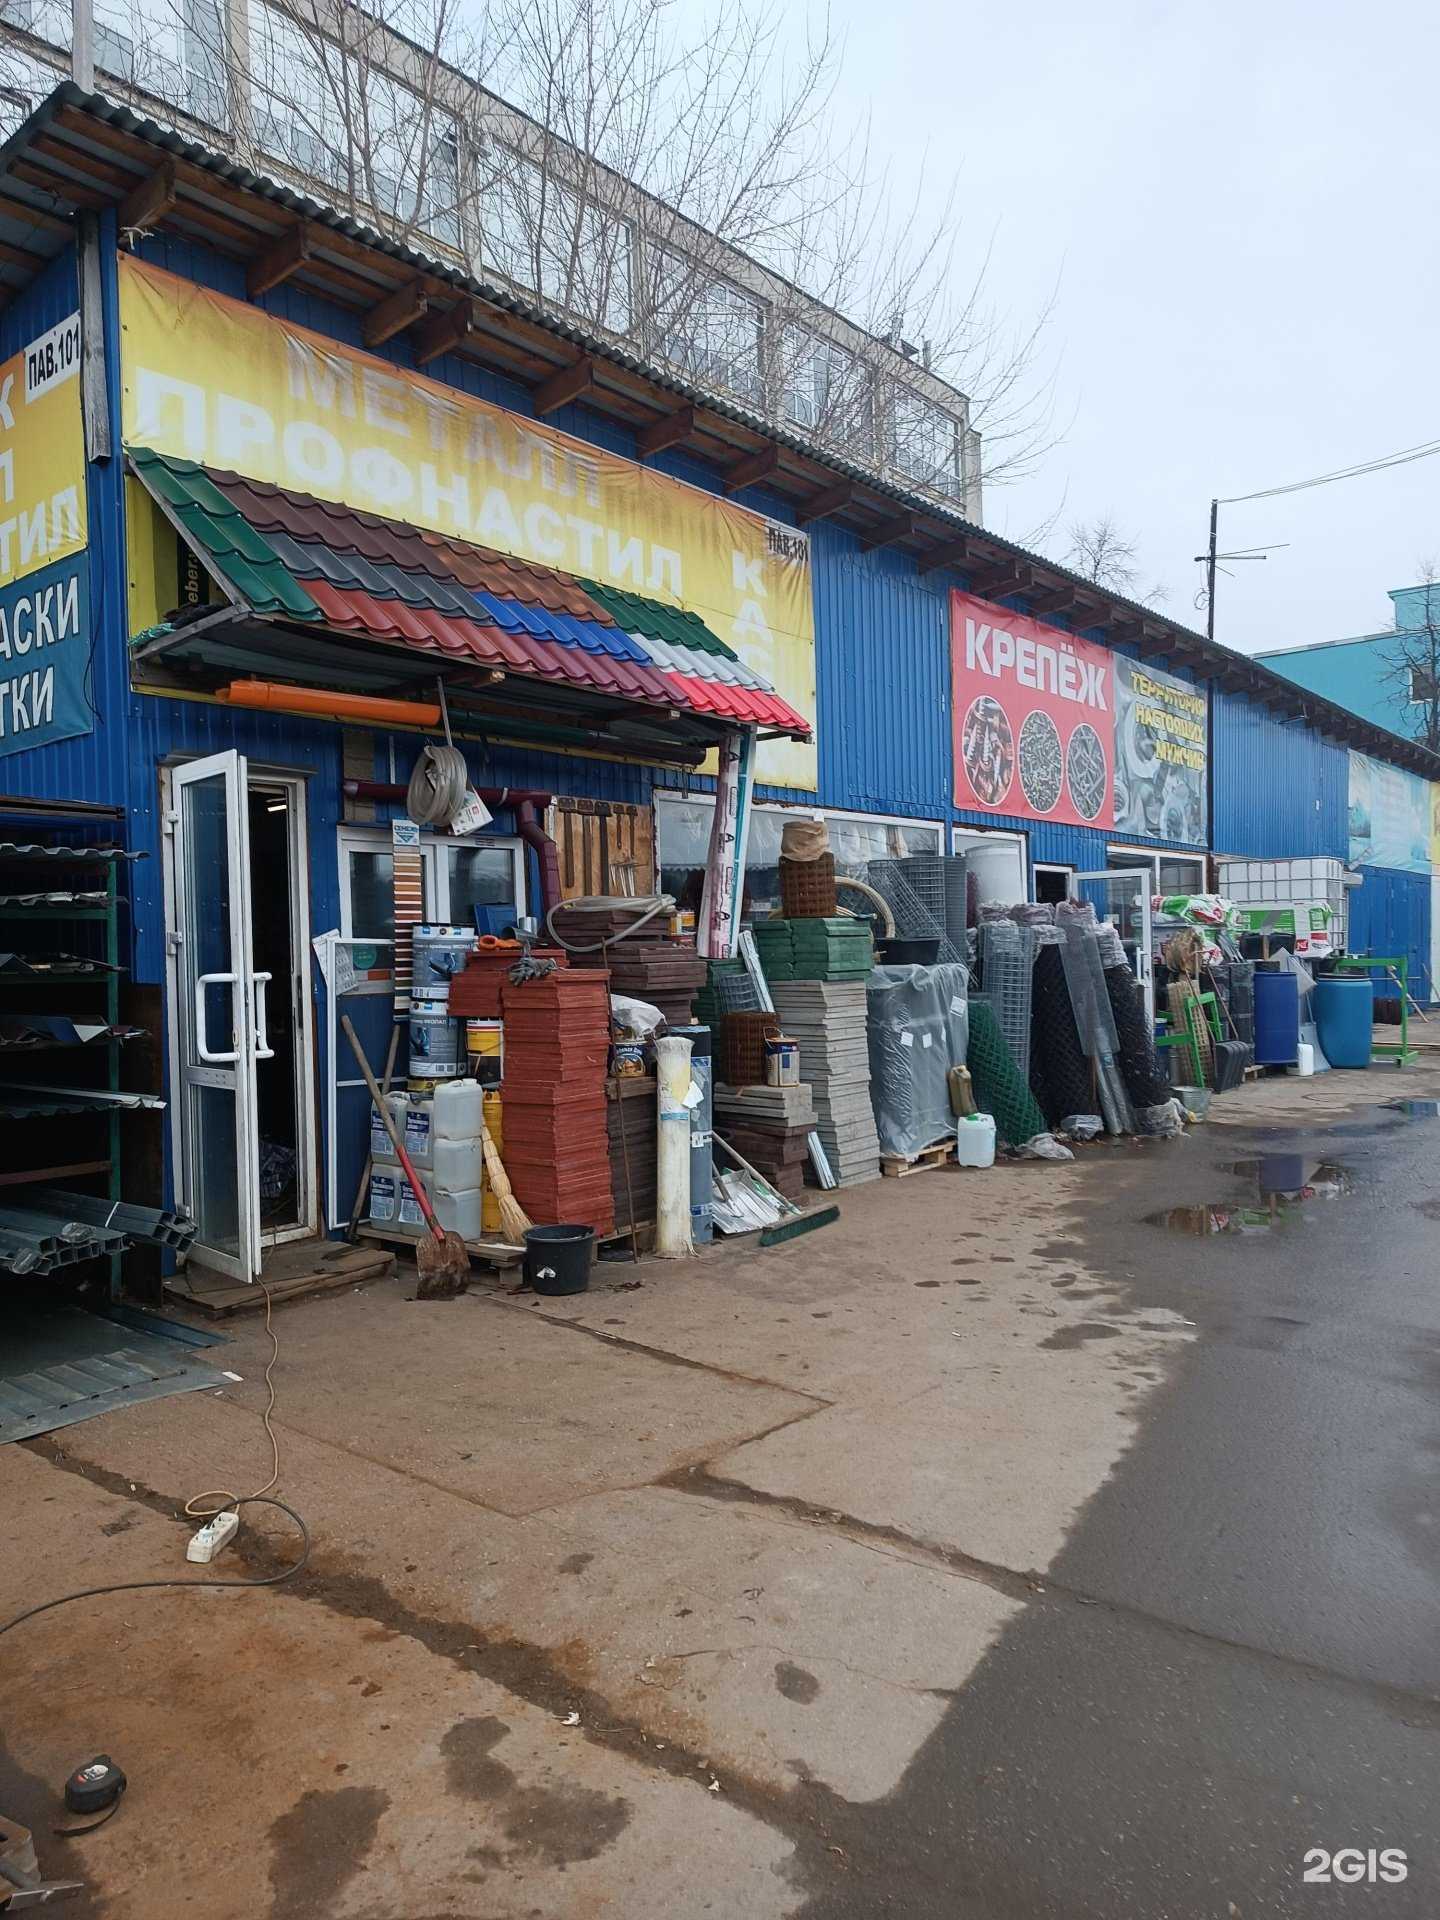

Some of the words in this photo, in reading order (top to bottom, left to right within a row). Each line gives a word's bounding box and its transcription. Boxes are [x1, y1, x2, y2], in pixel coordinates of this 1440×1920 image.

[28, 322, 80, 391] ПАВ.101
[135, 366, 683, 597] ПРОФНАСТИЛ
[965, 617, 1107, 712] КРЕПЁЖ
